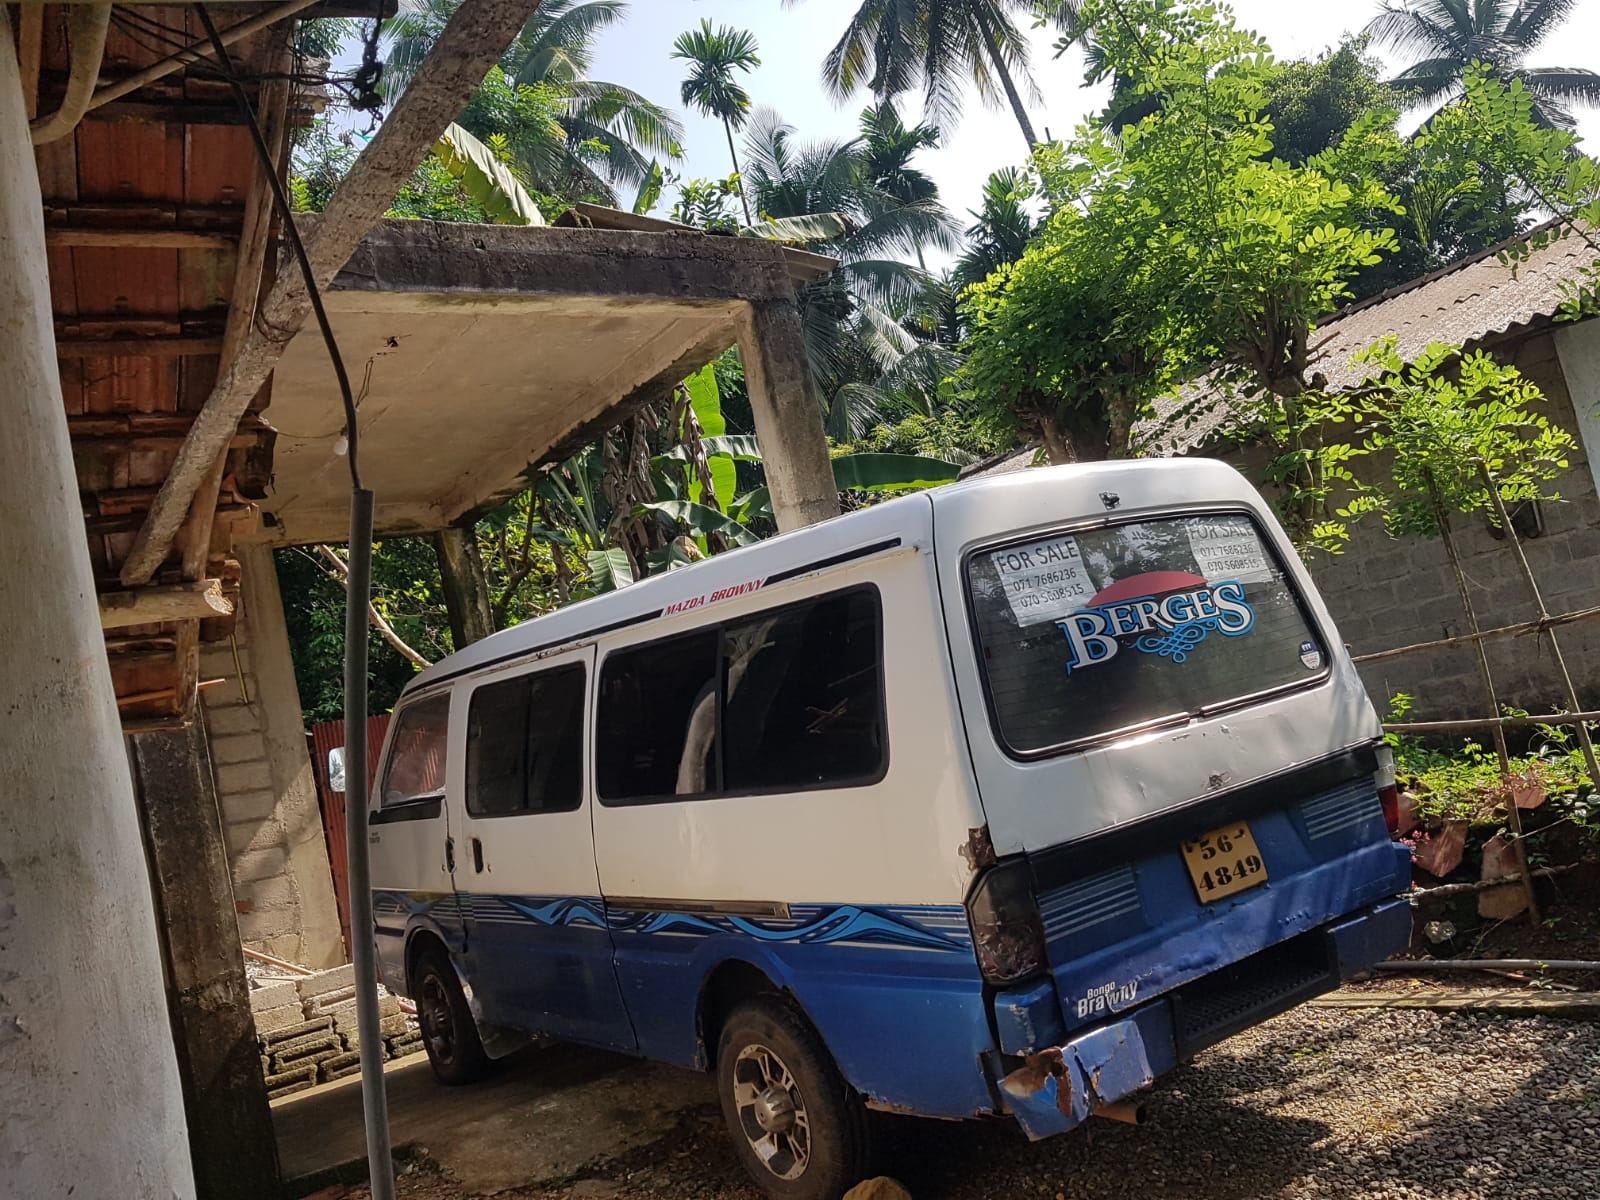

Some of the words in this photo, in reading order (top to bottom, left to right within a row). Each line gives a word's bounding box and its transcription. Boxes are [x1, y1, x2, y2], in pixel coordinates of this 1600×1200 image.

[1190, 525, 1218, 539] FOR
[1221, 525, 1254, 537] SALE
[997, 551, 1035, 574] FOR
[1036, 540, 1078, 565] SALE
[1201, 547, 1219, 558] 071
[1207, 560, 1223, 571] 070
[1013, 579, 1032, 592] 071
[1034, 567, 1076, 586] 7686236
[665, 595, 705, 615] MAZDA
[710, 579, 763, 602] BROWNY
[1020, 594, 1040, 607] 070
[1041, 583, 1084, 602] 5608515
[1055, 580, 1255, 672] BERGES
[1199, 855, 1261, 891] 4849
[1078, 981, 1137, 1018] Brawny
[1087, 981, 1115, 999] Bongo
